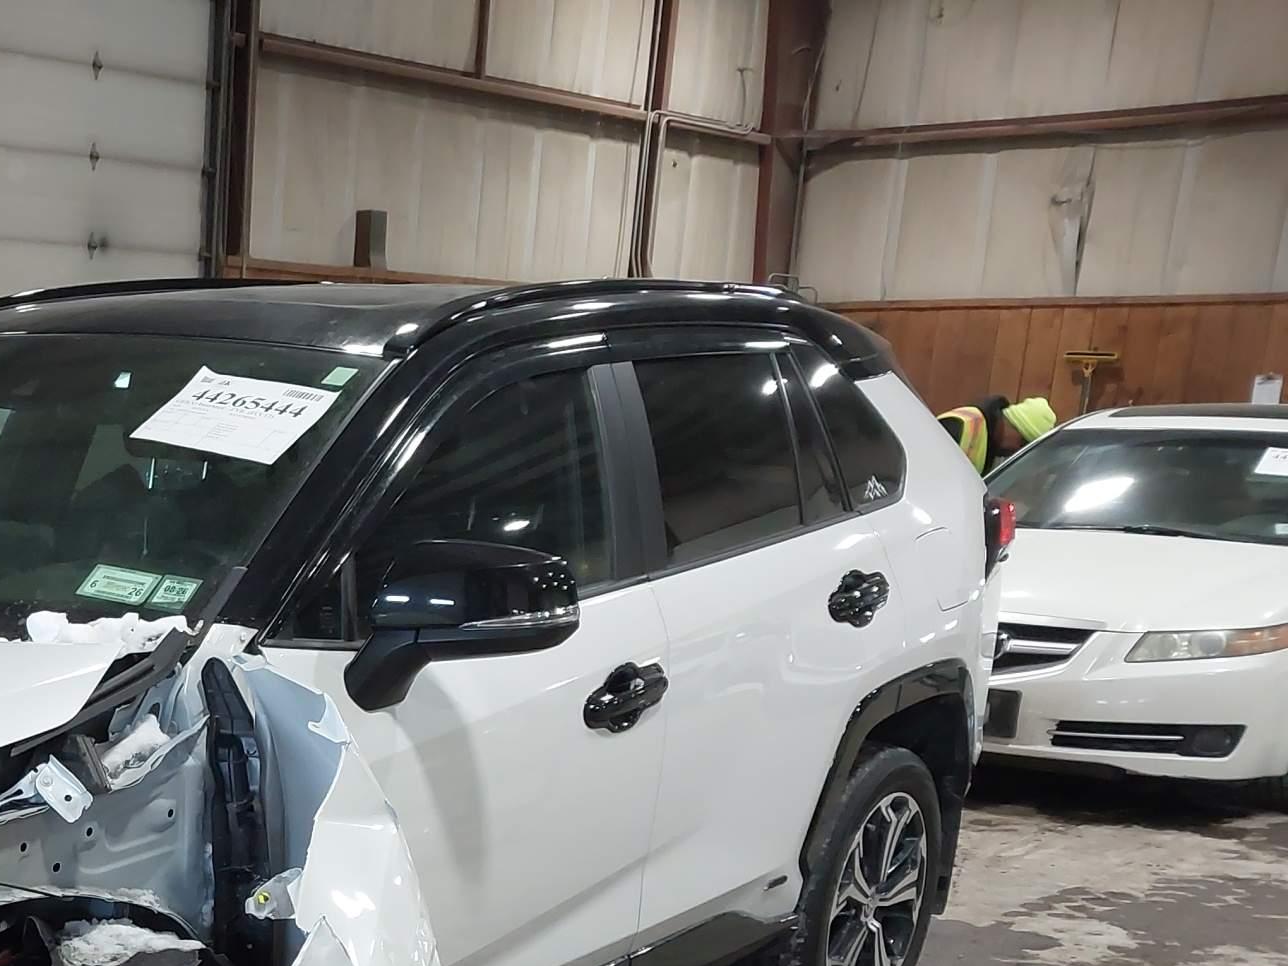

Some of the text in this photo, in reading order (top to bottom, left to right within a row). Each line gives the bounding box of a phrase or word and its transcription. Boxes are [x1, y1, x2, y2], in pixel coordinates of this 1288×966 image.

[191, 389, 309, 418] 44265444
[89, 579, 99, 588] 6
[128, 588, 144, 597] 26
